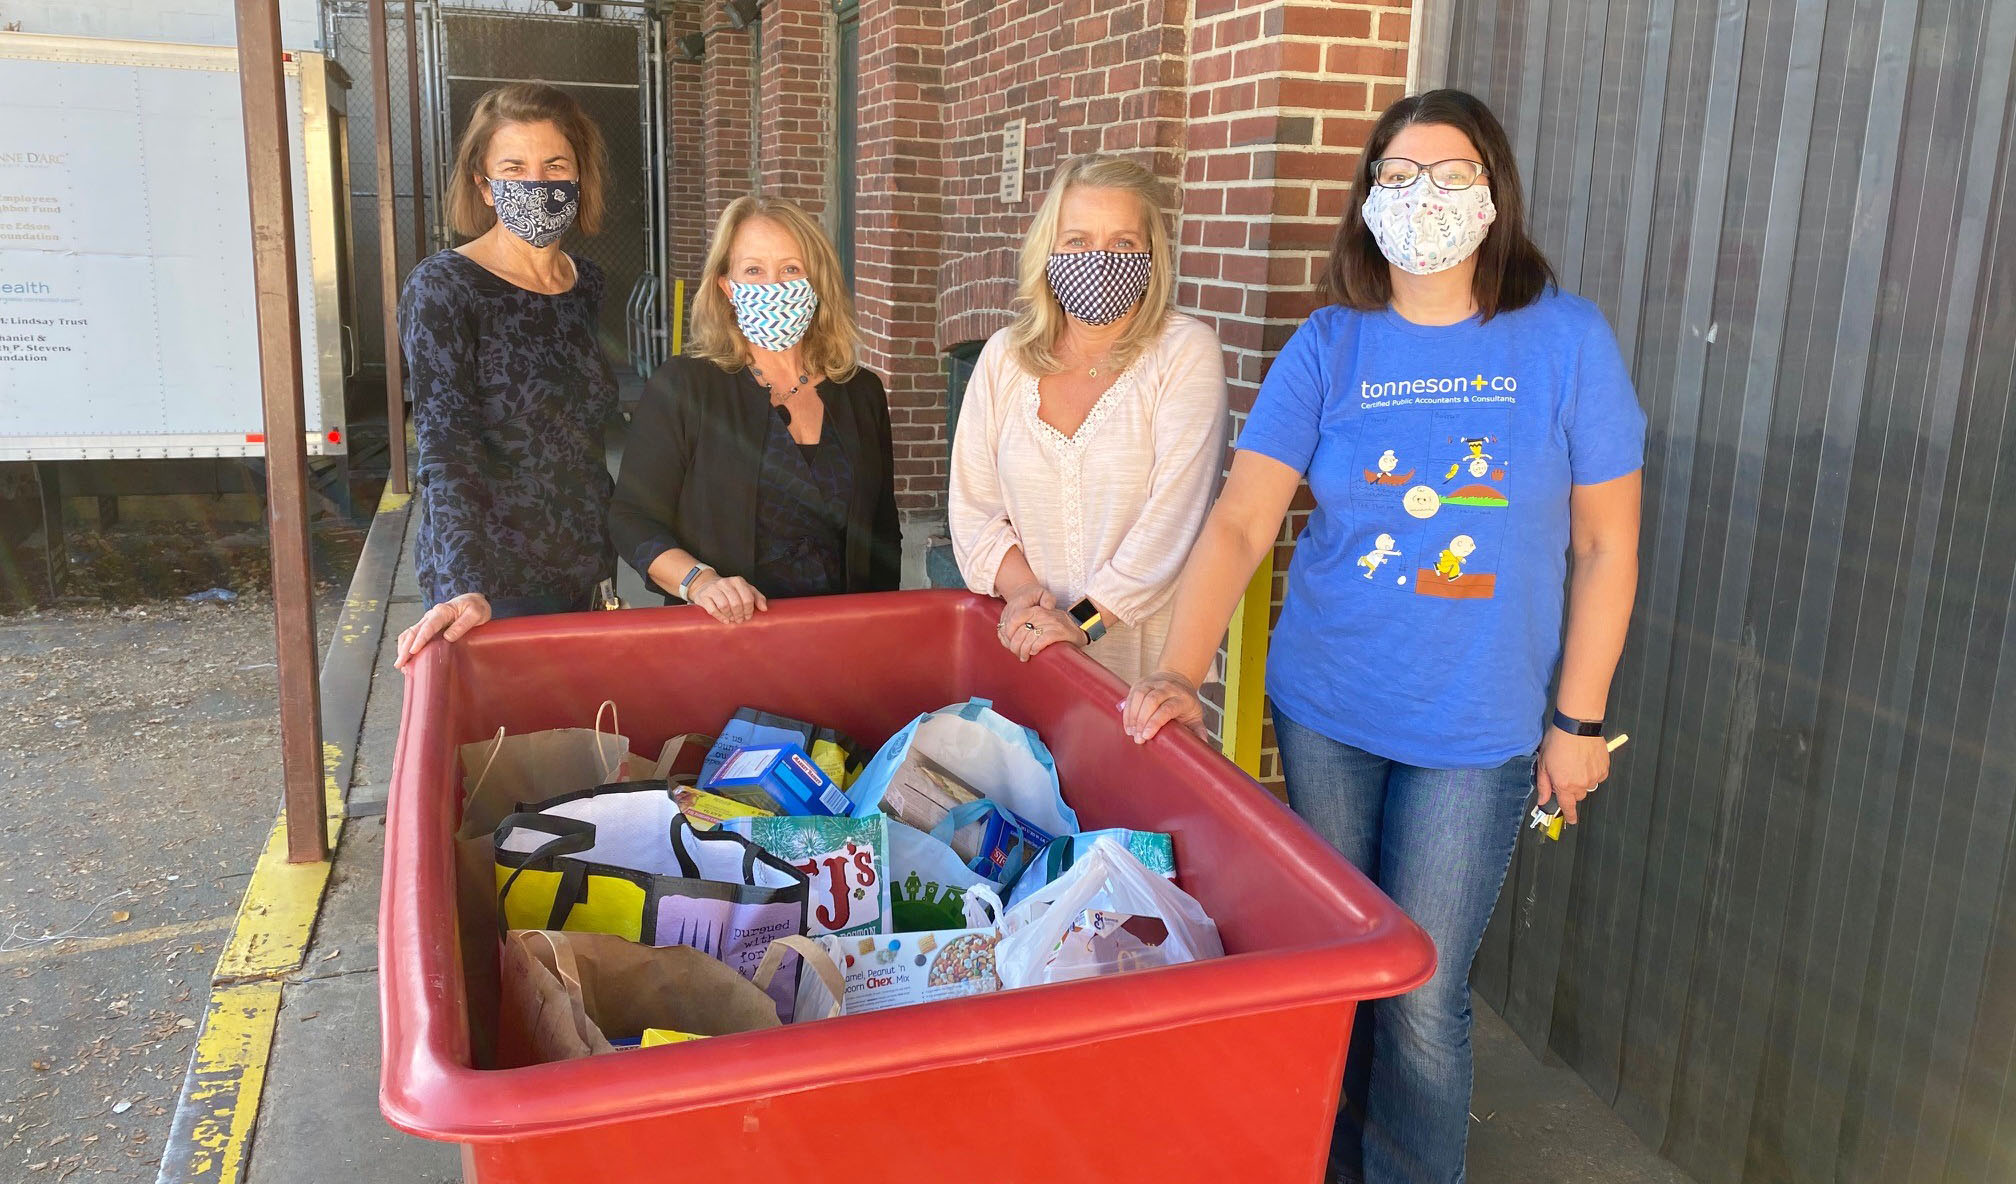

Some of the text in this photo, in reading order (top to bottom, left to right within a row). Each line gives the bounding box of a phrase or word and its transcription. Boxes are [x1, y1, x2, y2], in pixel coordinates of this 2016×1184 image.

[0, 195, 58, 204] mployees
[2, 281, 49, 294] ealth
[10, 316, 54, 326] Lindsay
[58, 318, 88, 326] Trust
[1361, 395, 1516, 409] Certified Public Accountants & Consultants
[733, 919, 790, 940] pursued
[744, 934, 775, 948] with
[740, 947, 767, 963] for
[867, 966, 896, 978] Peanut
[866, 976, 893, 989] Chex
[896, 975, 910, 984] Mix
